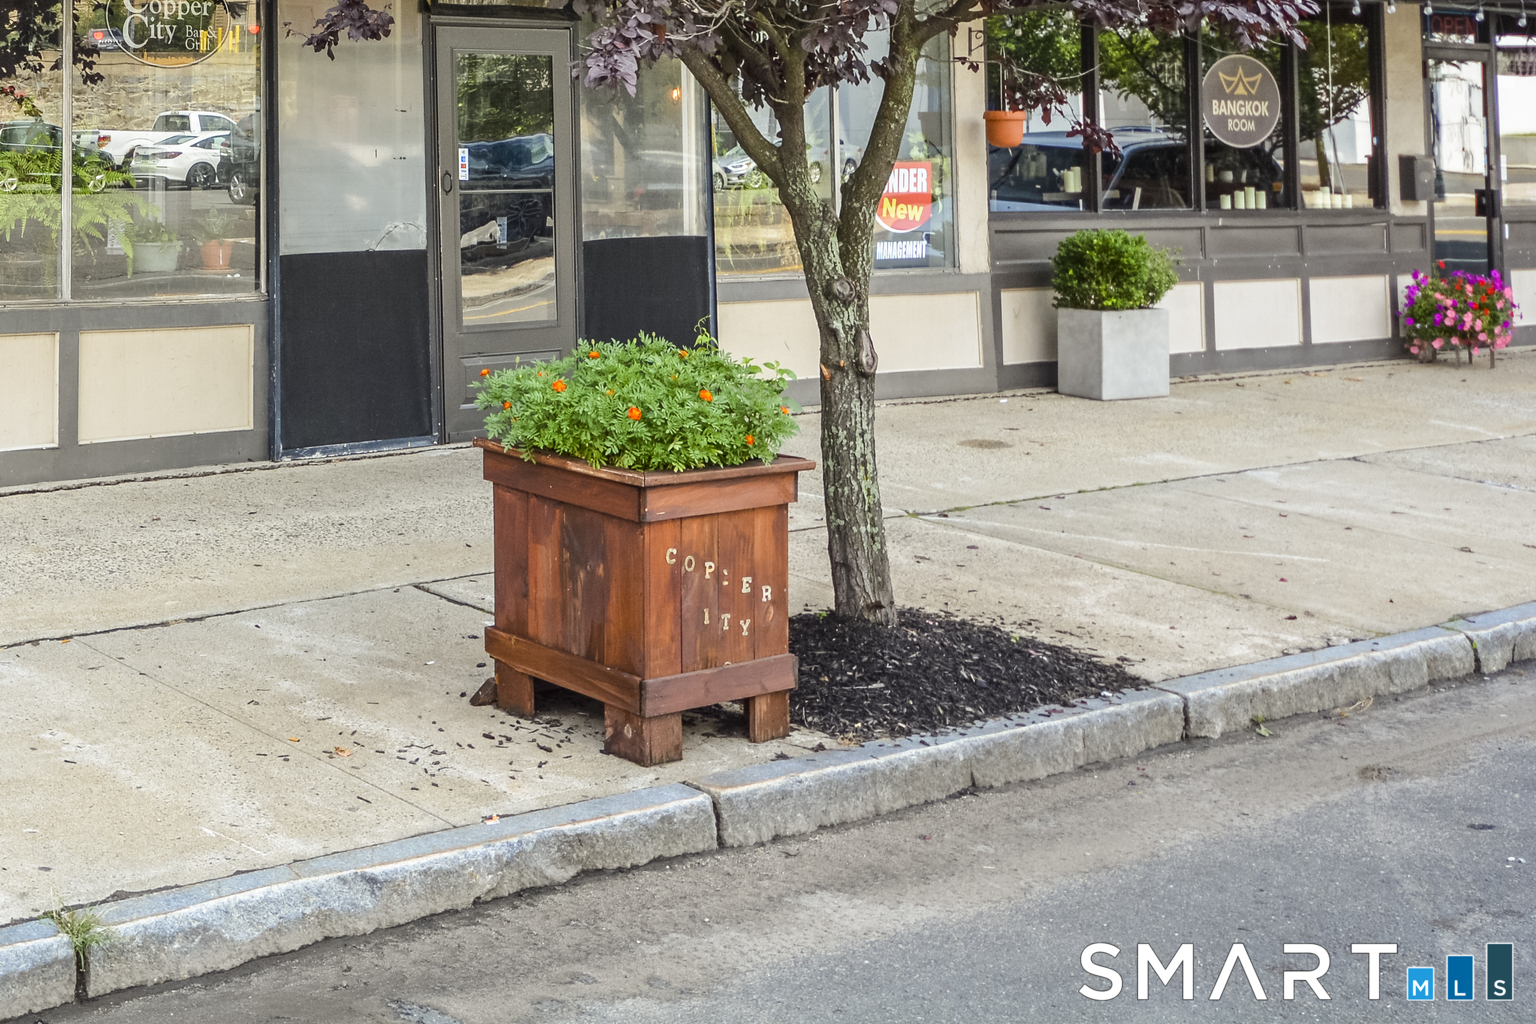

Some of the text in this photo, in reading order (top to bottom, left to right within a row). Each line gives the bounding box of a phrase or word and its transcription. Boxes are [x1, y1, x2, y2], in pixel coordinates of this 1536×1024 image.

[123, 13, 177, 49] City
[185, 25, 217, 38] Bar &
[1430, 16, 1476, 36] OPEN
[185, 37, 211, 51] Grill
[1212, 99, 1269, 117] BANGKOK
[1227, 118, 1255, 132] ROOM
[883, 167, 928, 193] NDER
[882, 197, 924, 222] New
[876, 240, 927, 260] MANAGEMENT
[666, 547, 772, 602] COPER
[703, 607, 751, 636] ITY
